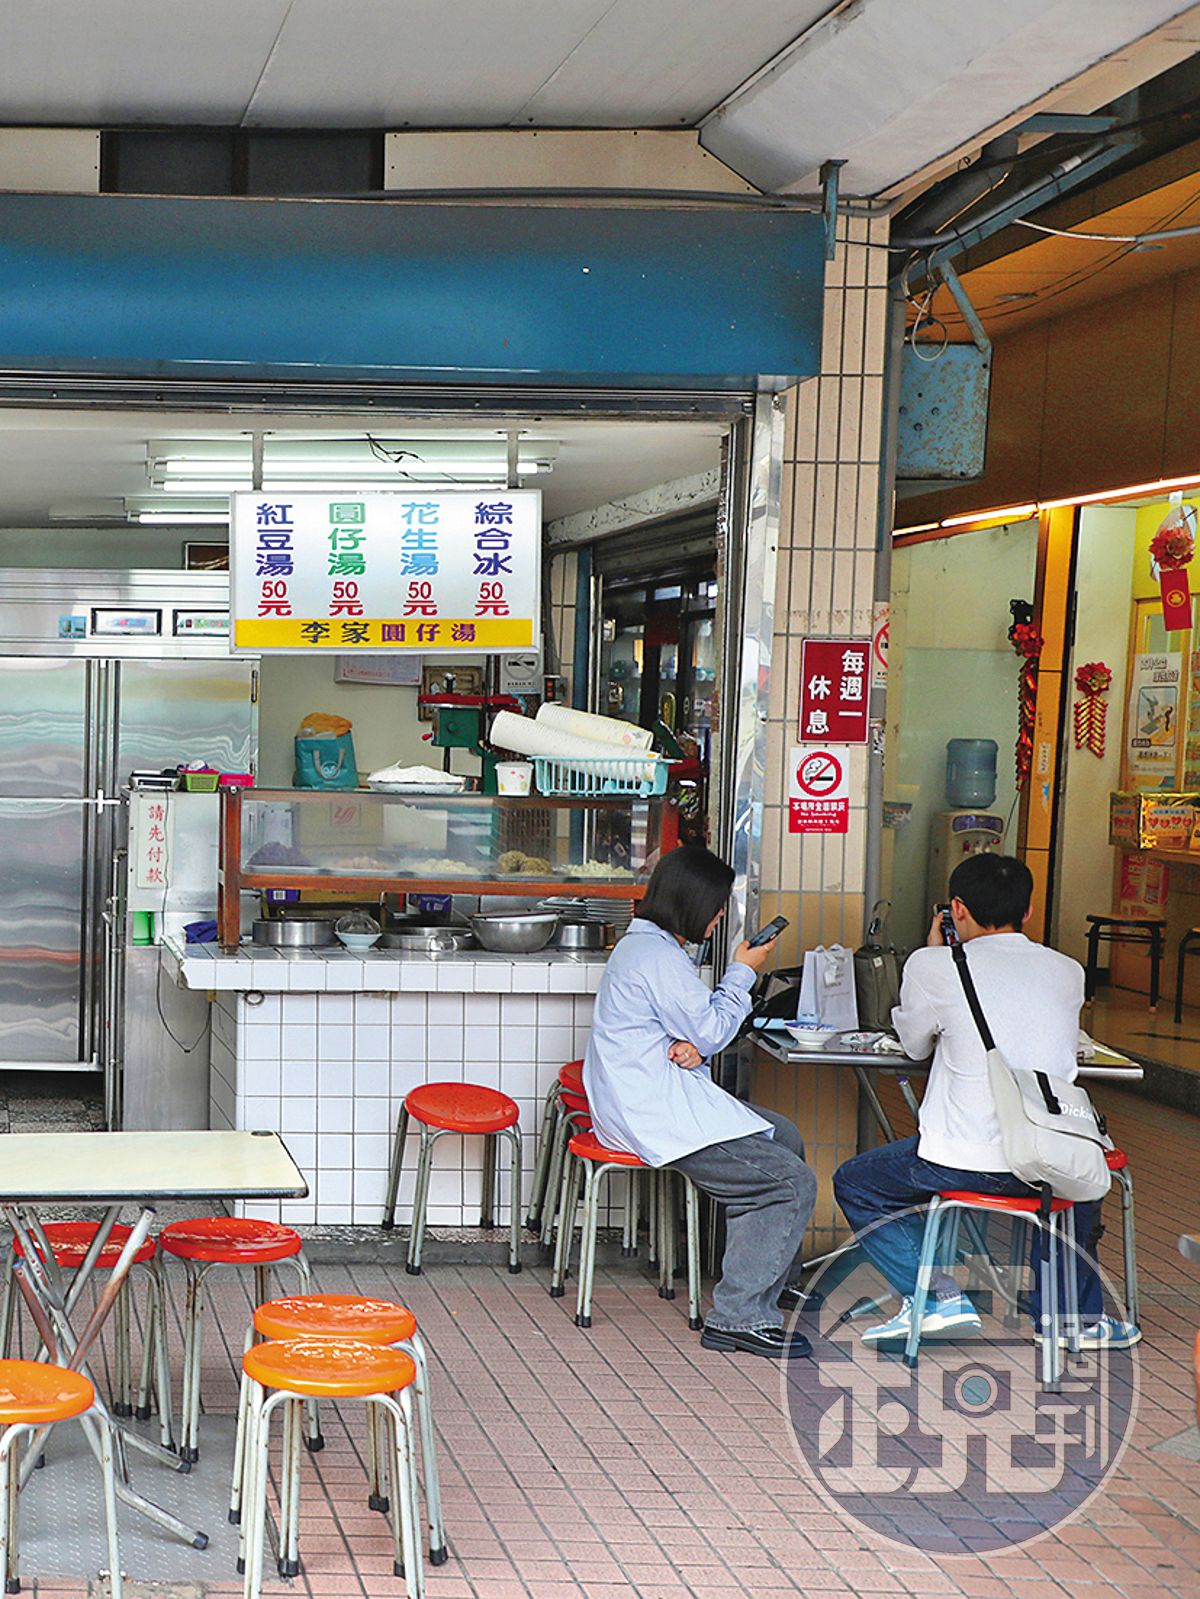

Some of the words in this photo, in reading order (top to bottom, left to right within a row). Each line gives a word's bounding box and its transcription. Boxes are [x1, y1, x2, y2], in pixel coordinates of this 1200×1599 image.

[256, 502, 294, 576] 紅豆湯
[327, 502, 366, 576] 圓仔湯
[400, 502, 440, 576] 花生湯
[473, 501, 513, 576] 綜合冰
[300, 621, 476, 644] 李家圓仔湯
[805, 674, 832, 735] 休息
[838, 649, 866, 717] 每週一
[146, 804, 165, 883] 請先付款
